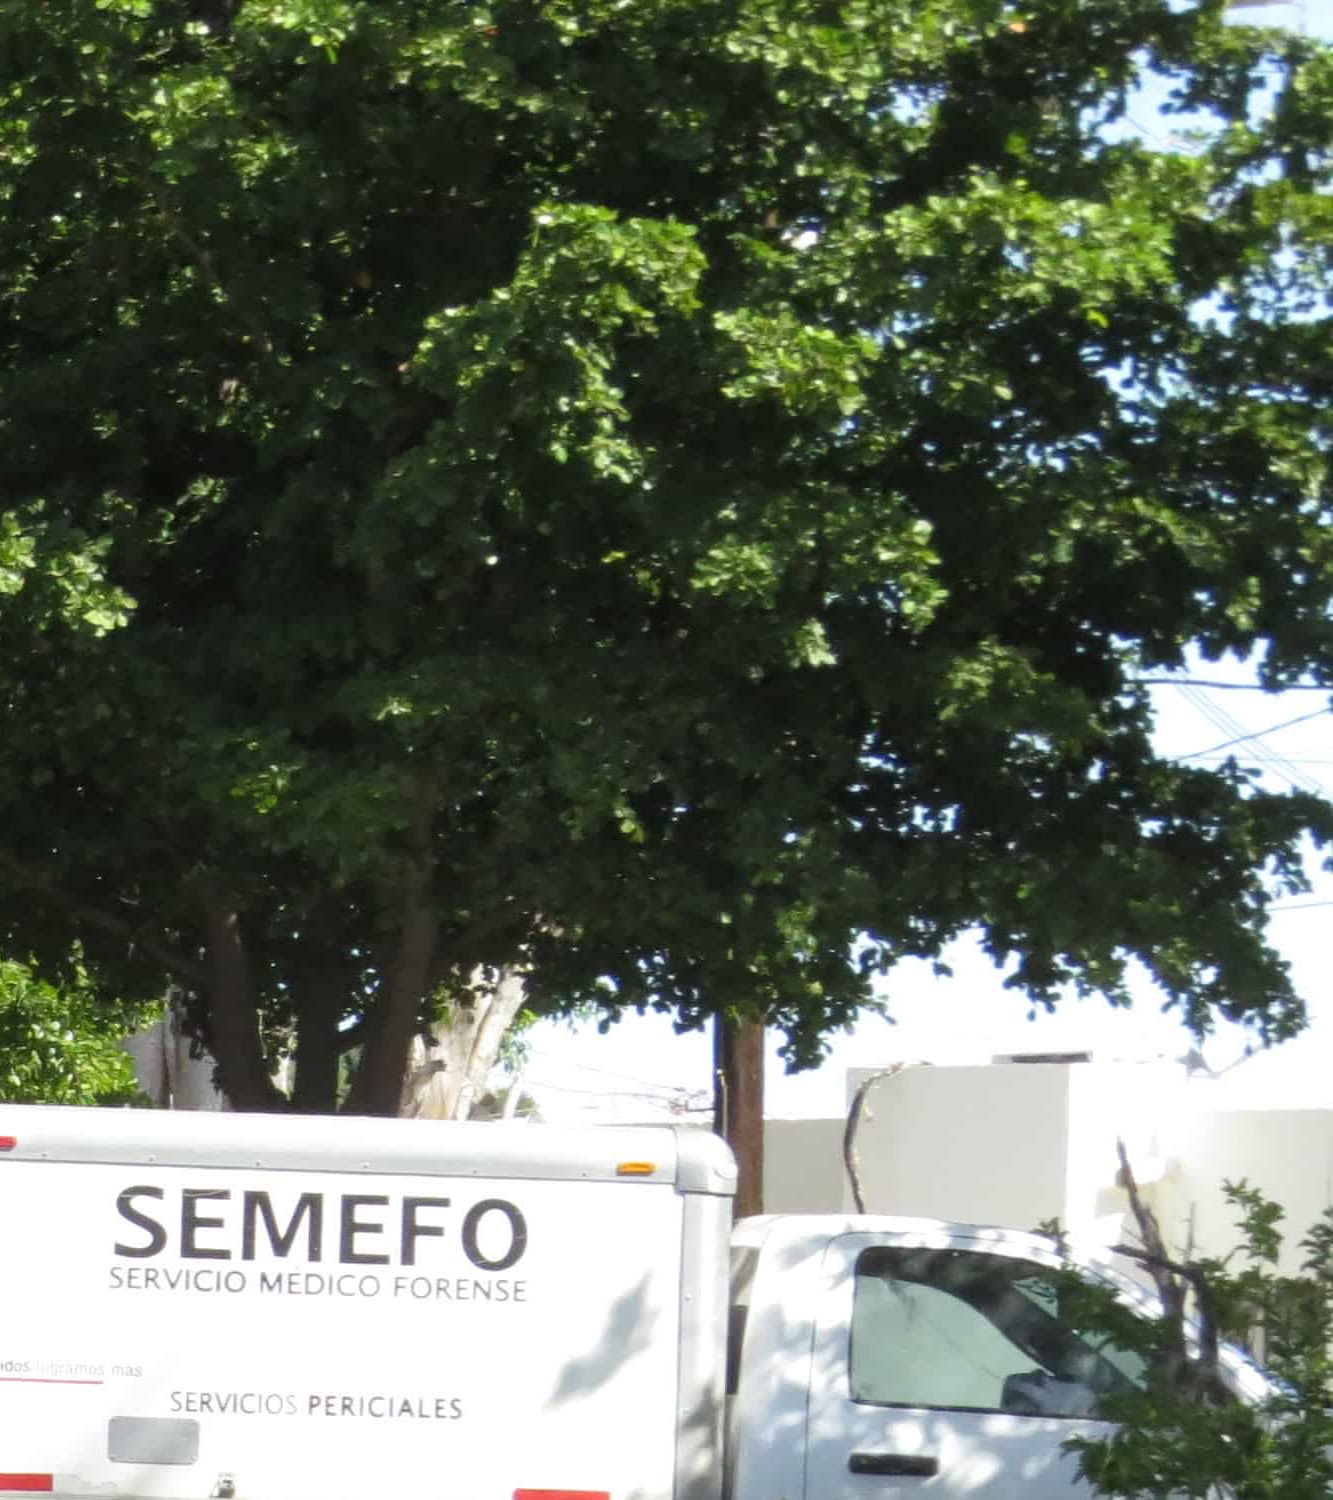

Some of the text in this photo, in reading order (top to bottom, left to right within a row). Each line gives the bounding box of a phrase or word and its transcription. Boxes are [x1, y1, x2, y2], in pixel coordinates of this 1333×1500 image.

[114, 1185, 528, 1272] SEMEFO
[108, 1266, 247, 1293] SERVICIO
[393, 1276, 527, 1302] FORENSE
[170, 1391, 463, 1420] SERVICIOS PERICIALES
